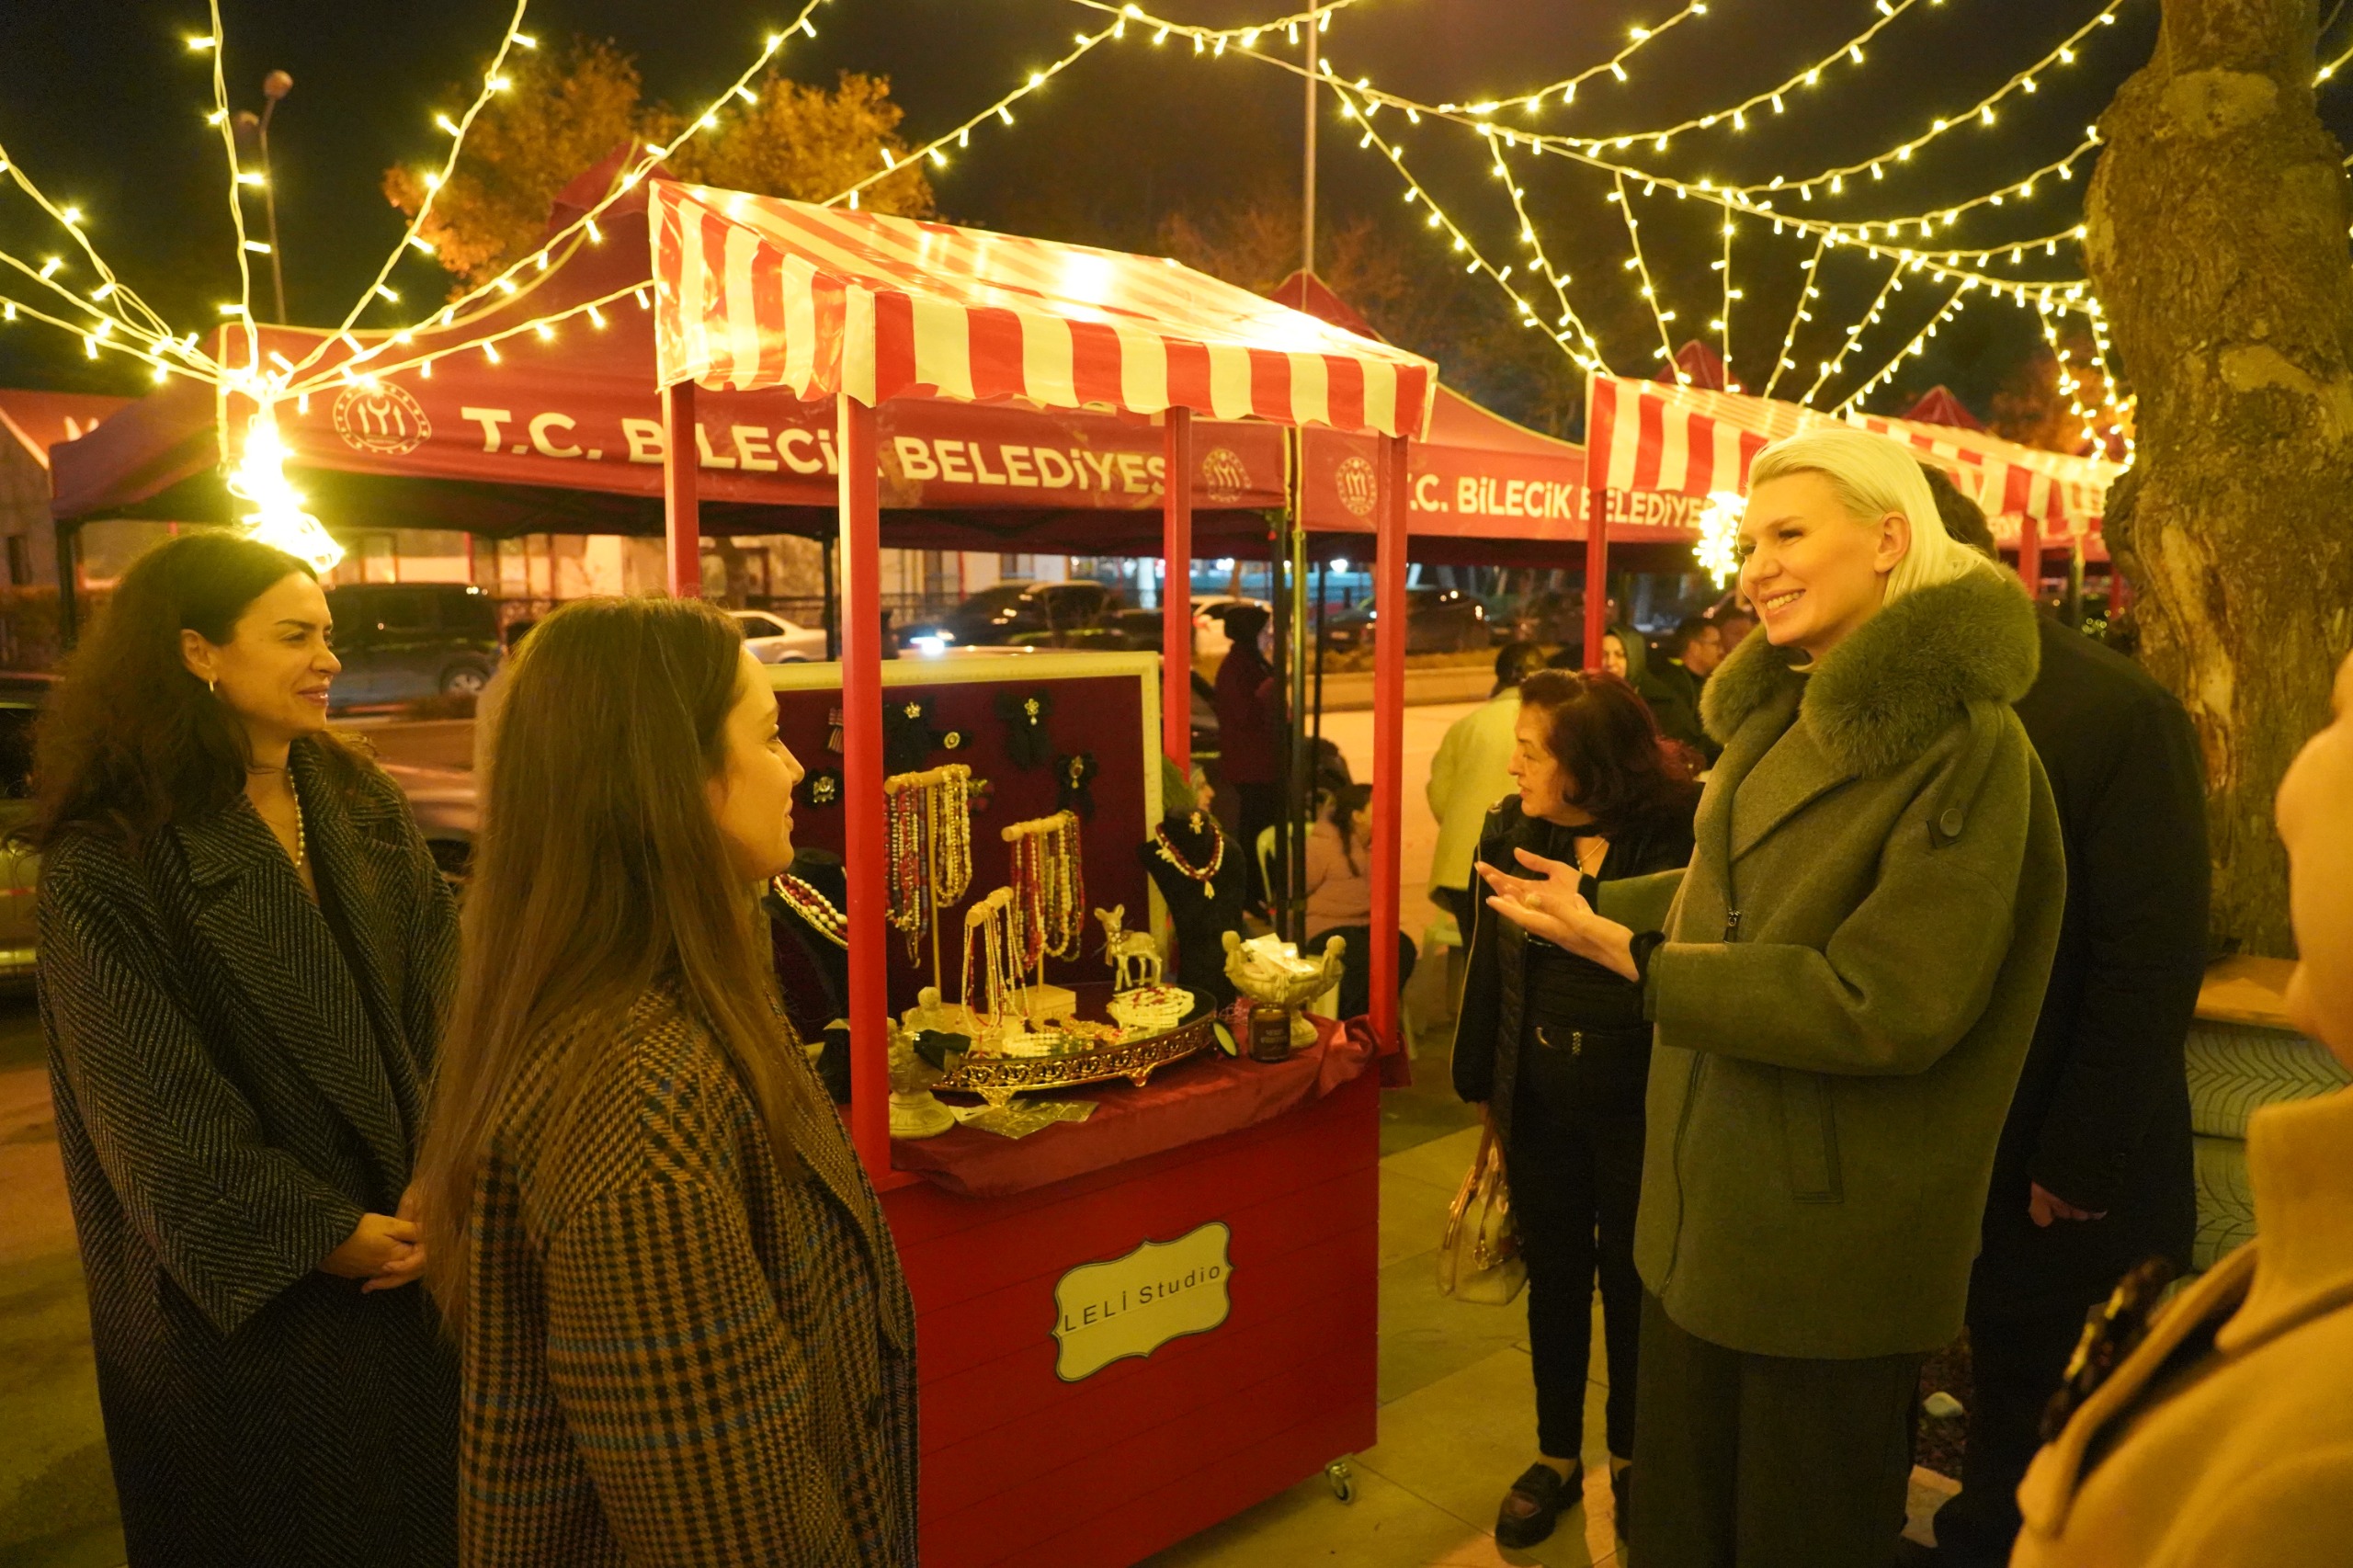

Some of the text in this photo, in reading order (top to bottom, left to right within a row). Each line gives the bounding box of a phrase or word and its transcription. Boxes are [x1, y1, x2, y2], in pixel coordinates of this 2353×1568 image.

[460, 406, 1165, 496] T.C. BLECi BELEDiYES
[1407, 472, 1449, 513] .C.
[1139, 1266, 1221, 1304] Studio
